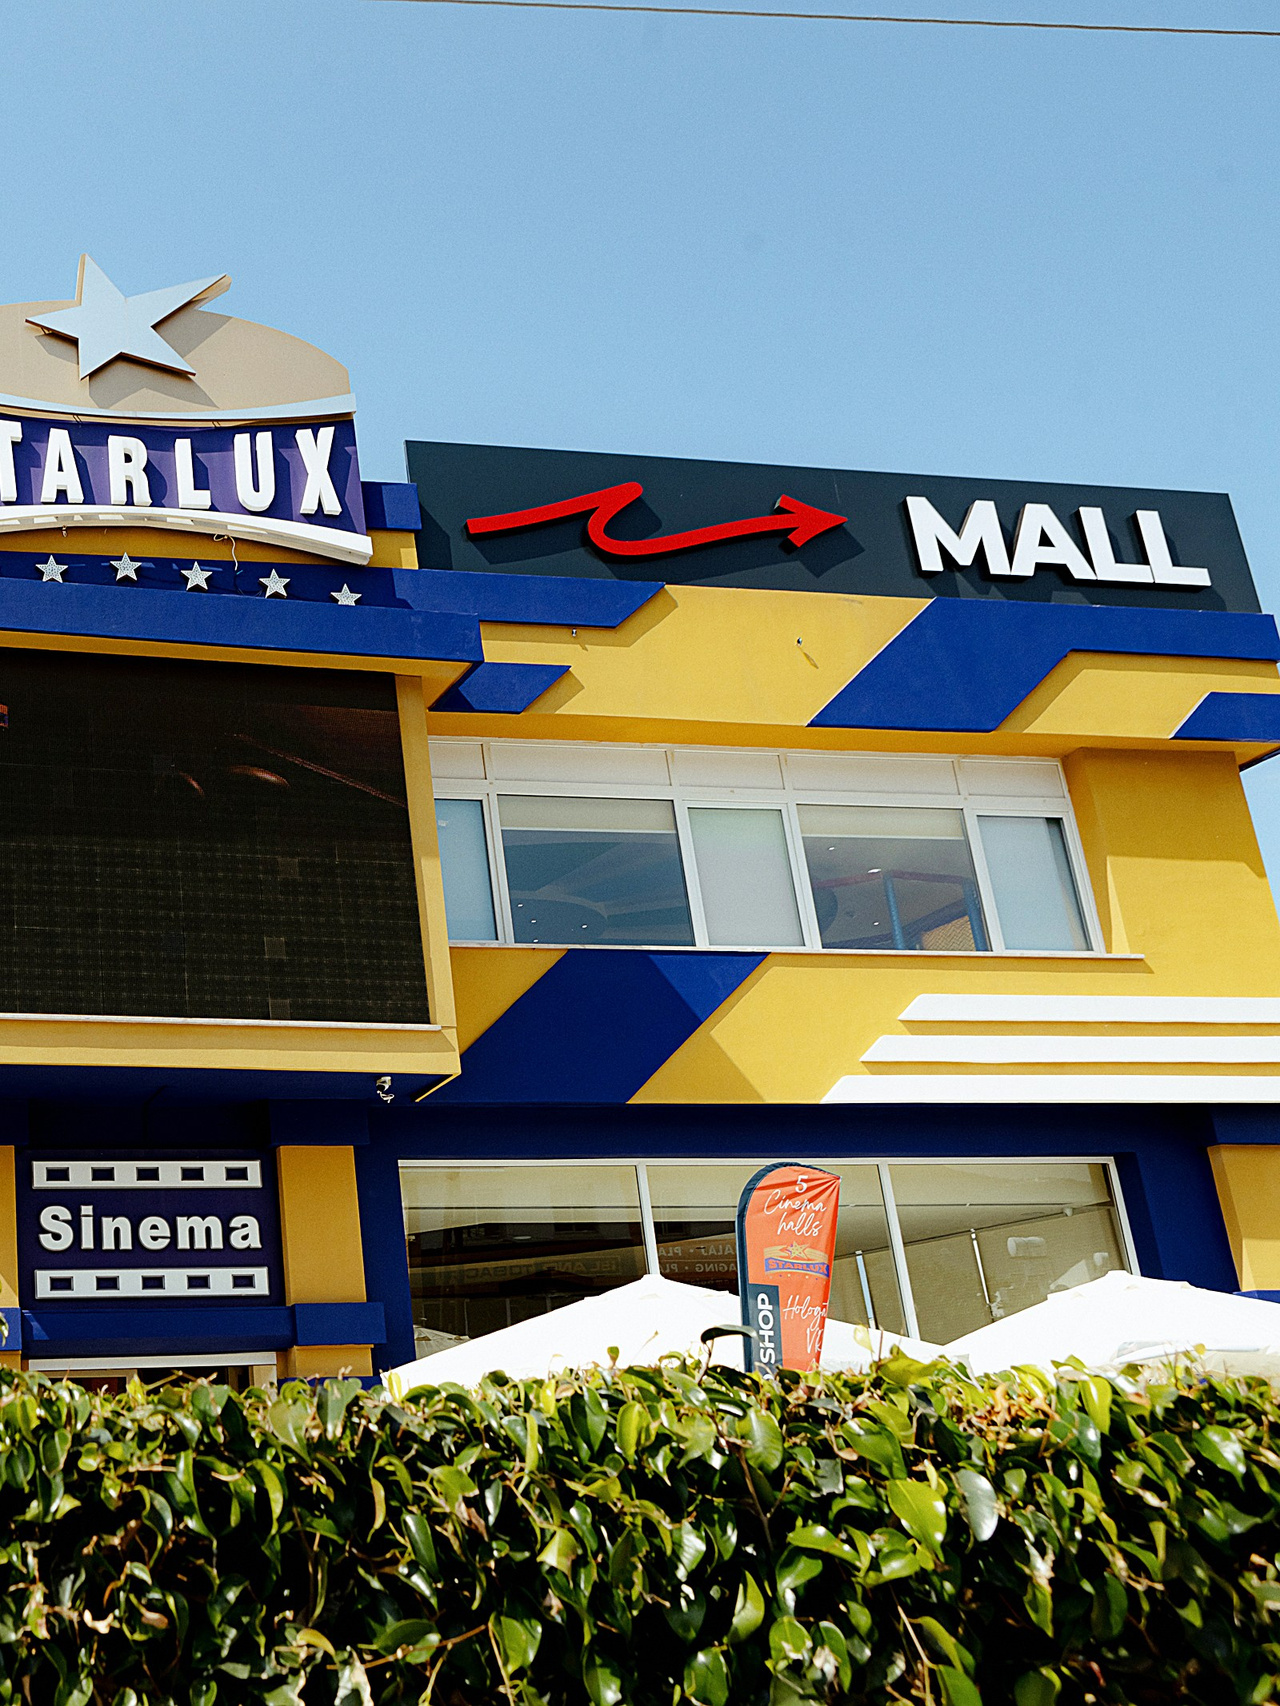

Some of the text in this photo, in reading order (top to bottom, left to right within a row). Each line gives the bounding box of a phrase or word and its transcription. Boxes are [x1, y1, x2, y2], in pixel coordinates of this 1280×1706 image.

[905, 496, 1213, 587] MALL
[795, 1175, 808, 1194] 5
[764, 1189, 827, 1216] Cinema
[38, 1205, 262, 1252] Sinema
[776, 1212, 823, 1237] halls
[768, 1259, 829, 1275] STARLUX
[757, 1293, 776, 1364] SHOP
